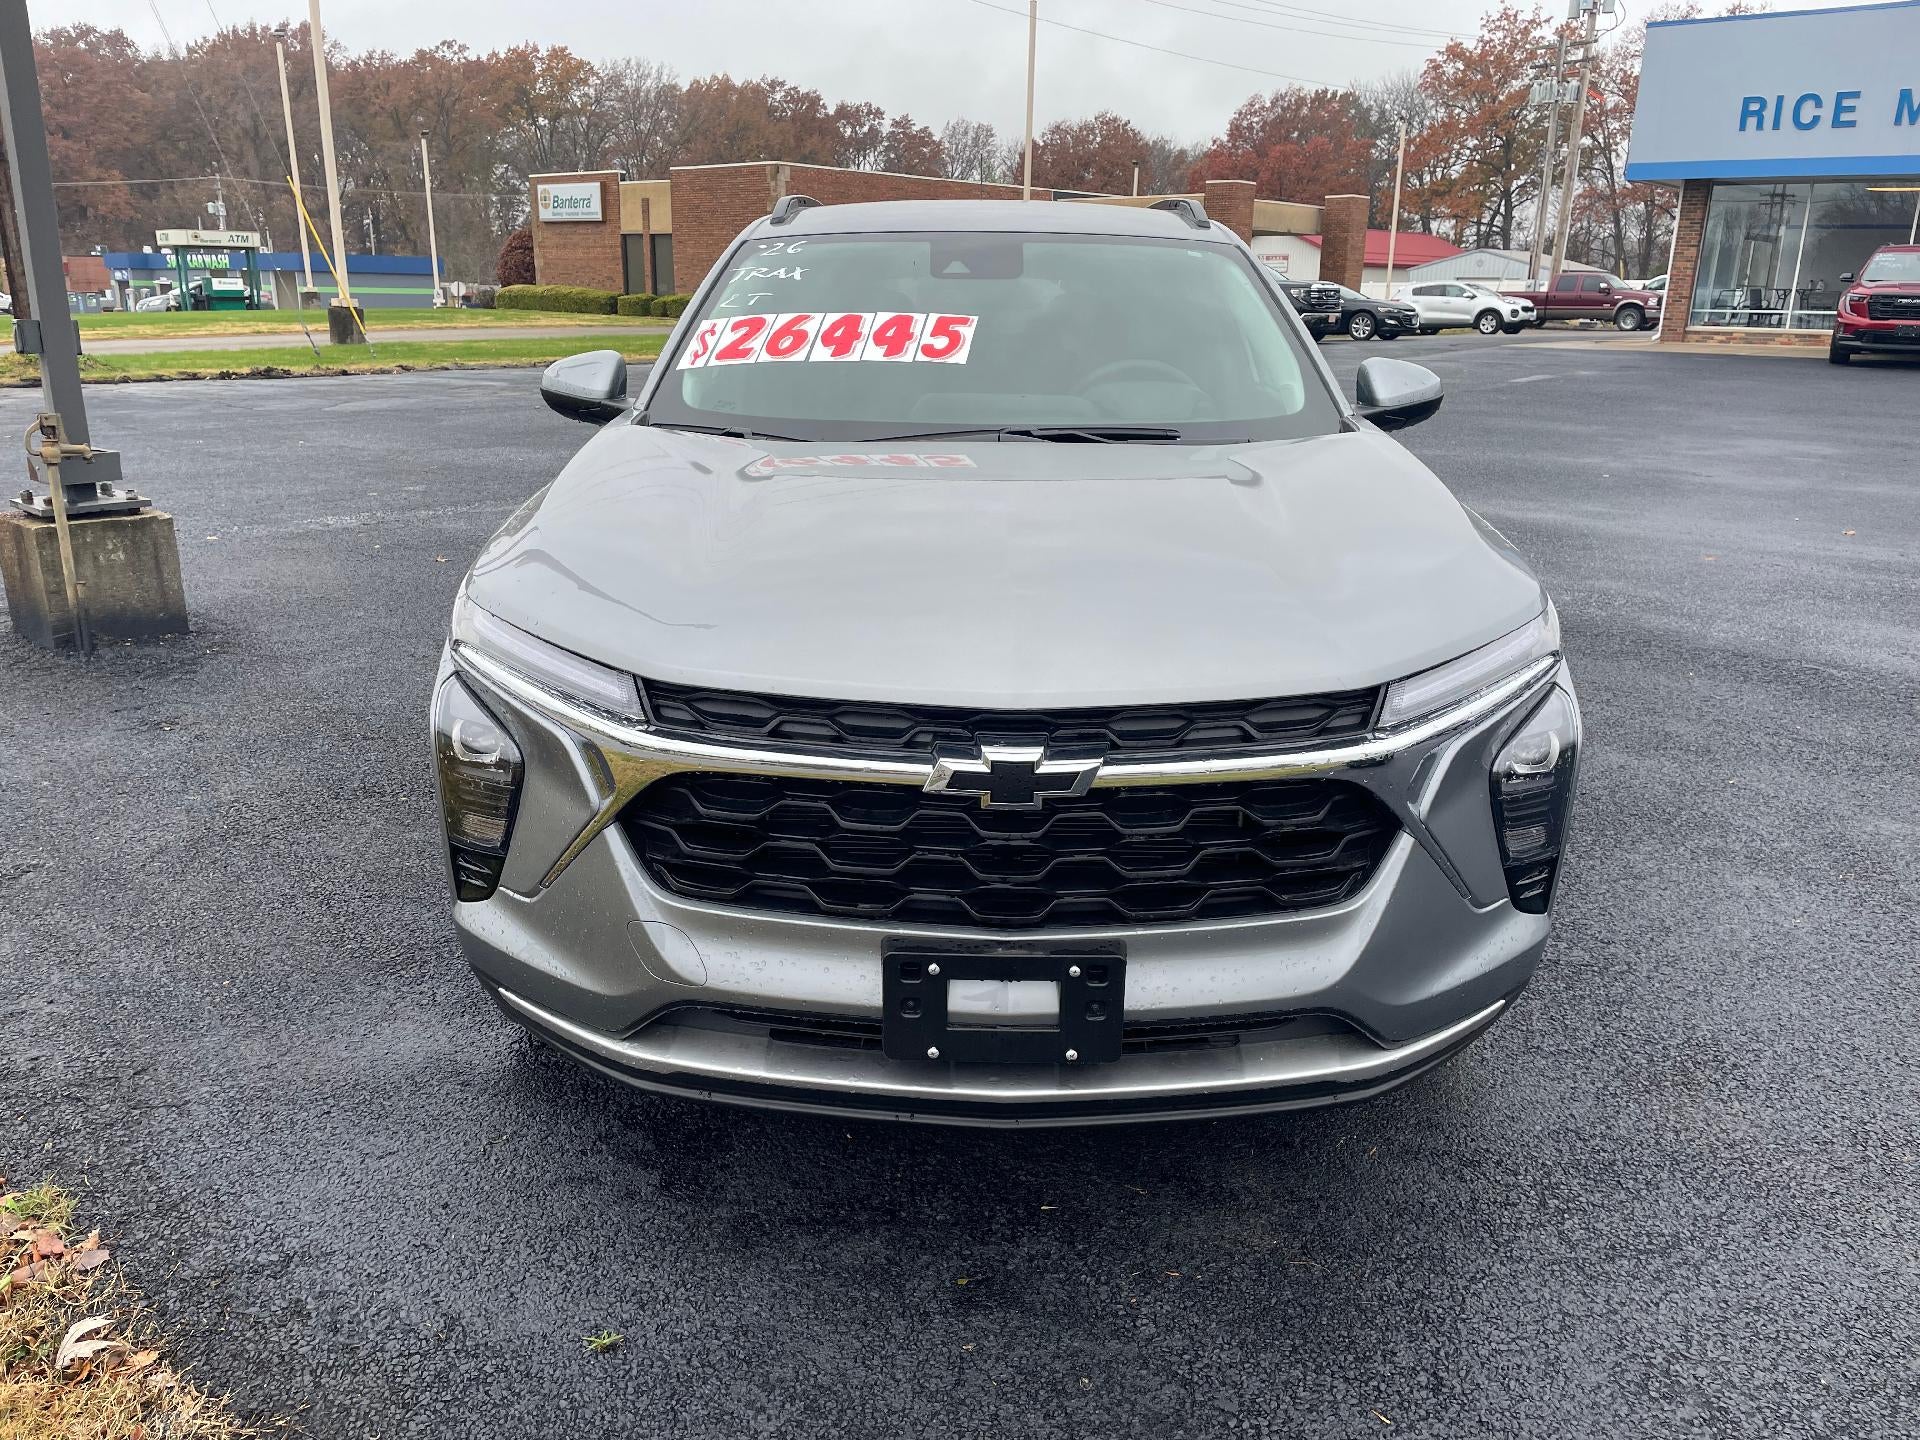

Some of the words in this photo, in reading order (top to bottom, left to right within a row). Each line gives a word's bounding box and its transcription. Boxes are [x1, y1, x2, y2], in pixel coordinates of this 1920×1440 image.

[1739, 91, 1862, 132] RICE
[552, 195, 591, 209] Banterra
[228, 234, 249, 243] ATM
[730, 267, 811, 284] TRAX
[720, 293, 774, 307] LT
[689, 314, 971, 366] $26445
